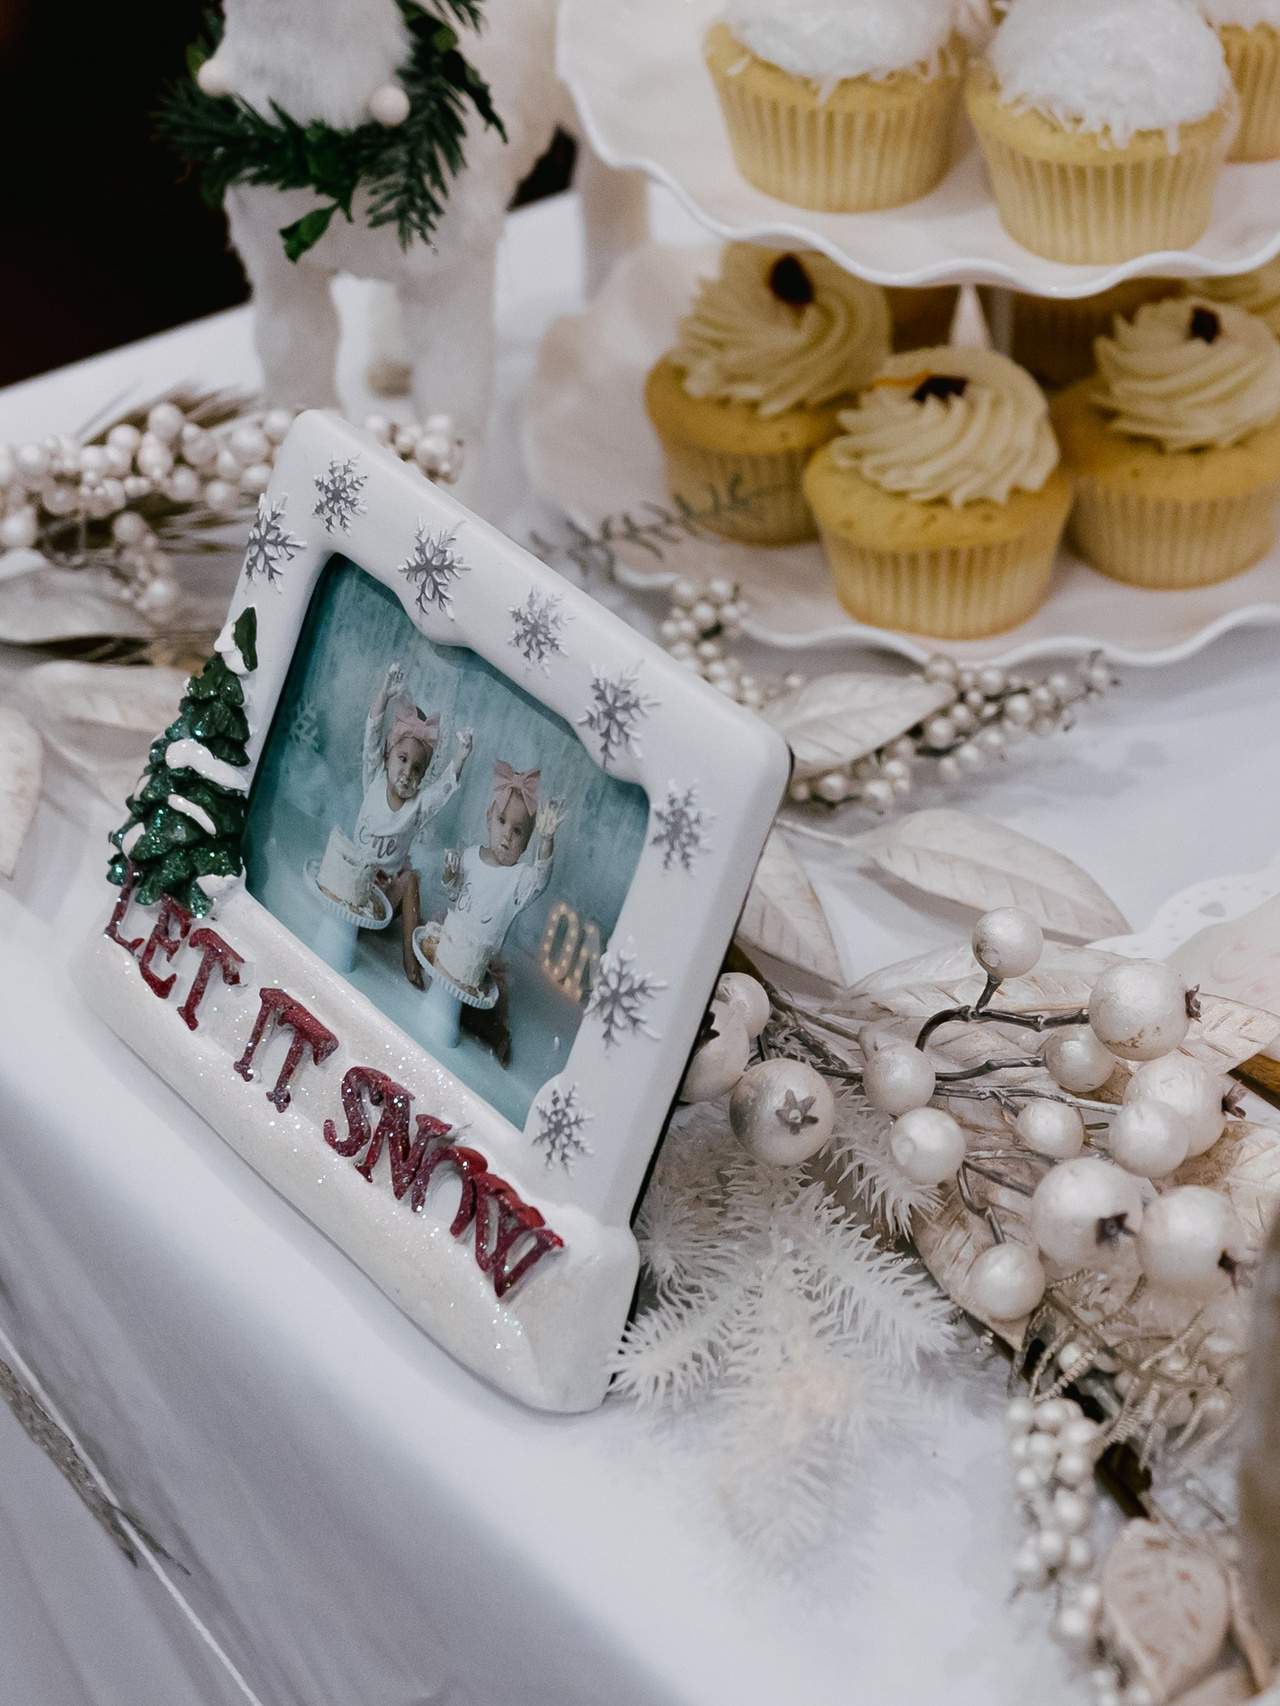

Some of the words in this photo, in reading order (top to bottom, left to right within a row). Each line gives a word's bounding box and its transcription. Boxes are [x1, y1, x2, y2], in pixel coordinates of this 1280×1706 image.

[103, 858, 246, 1031] LET
[233, 987, 340, 1113] IT
[323, 1066, 565, 1298] SNOW
